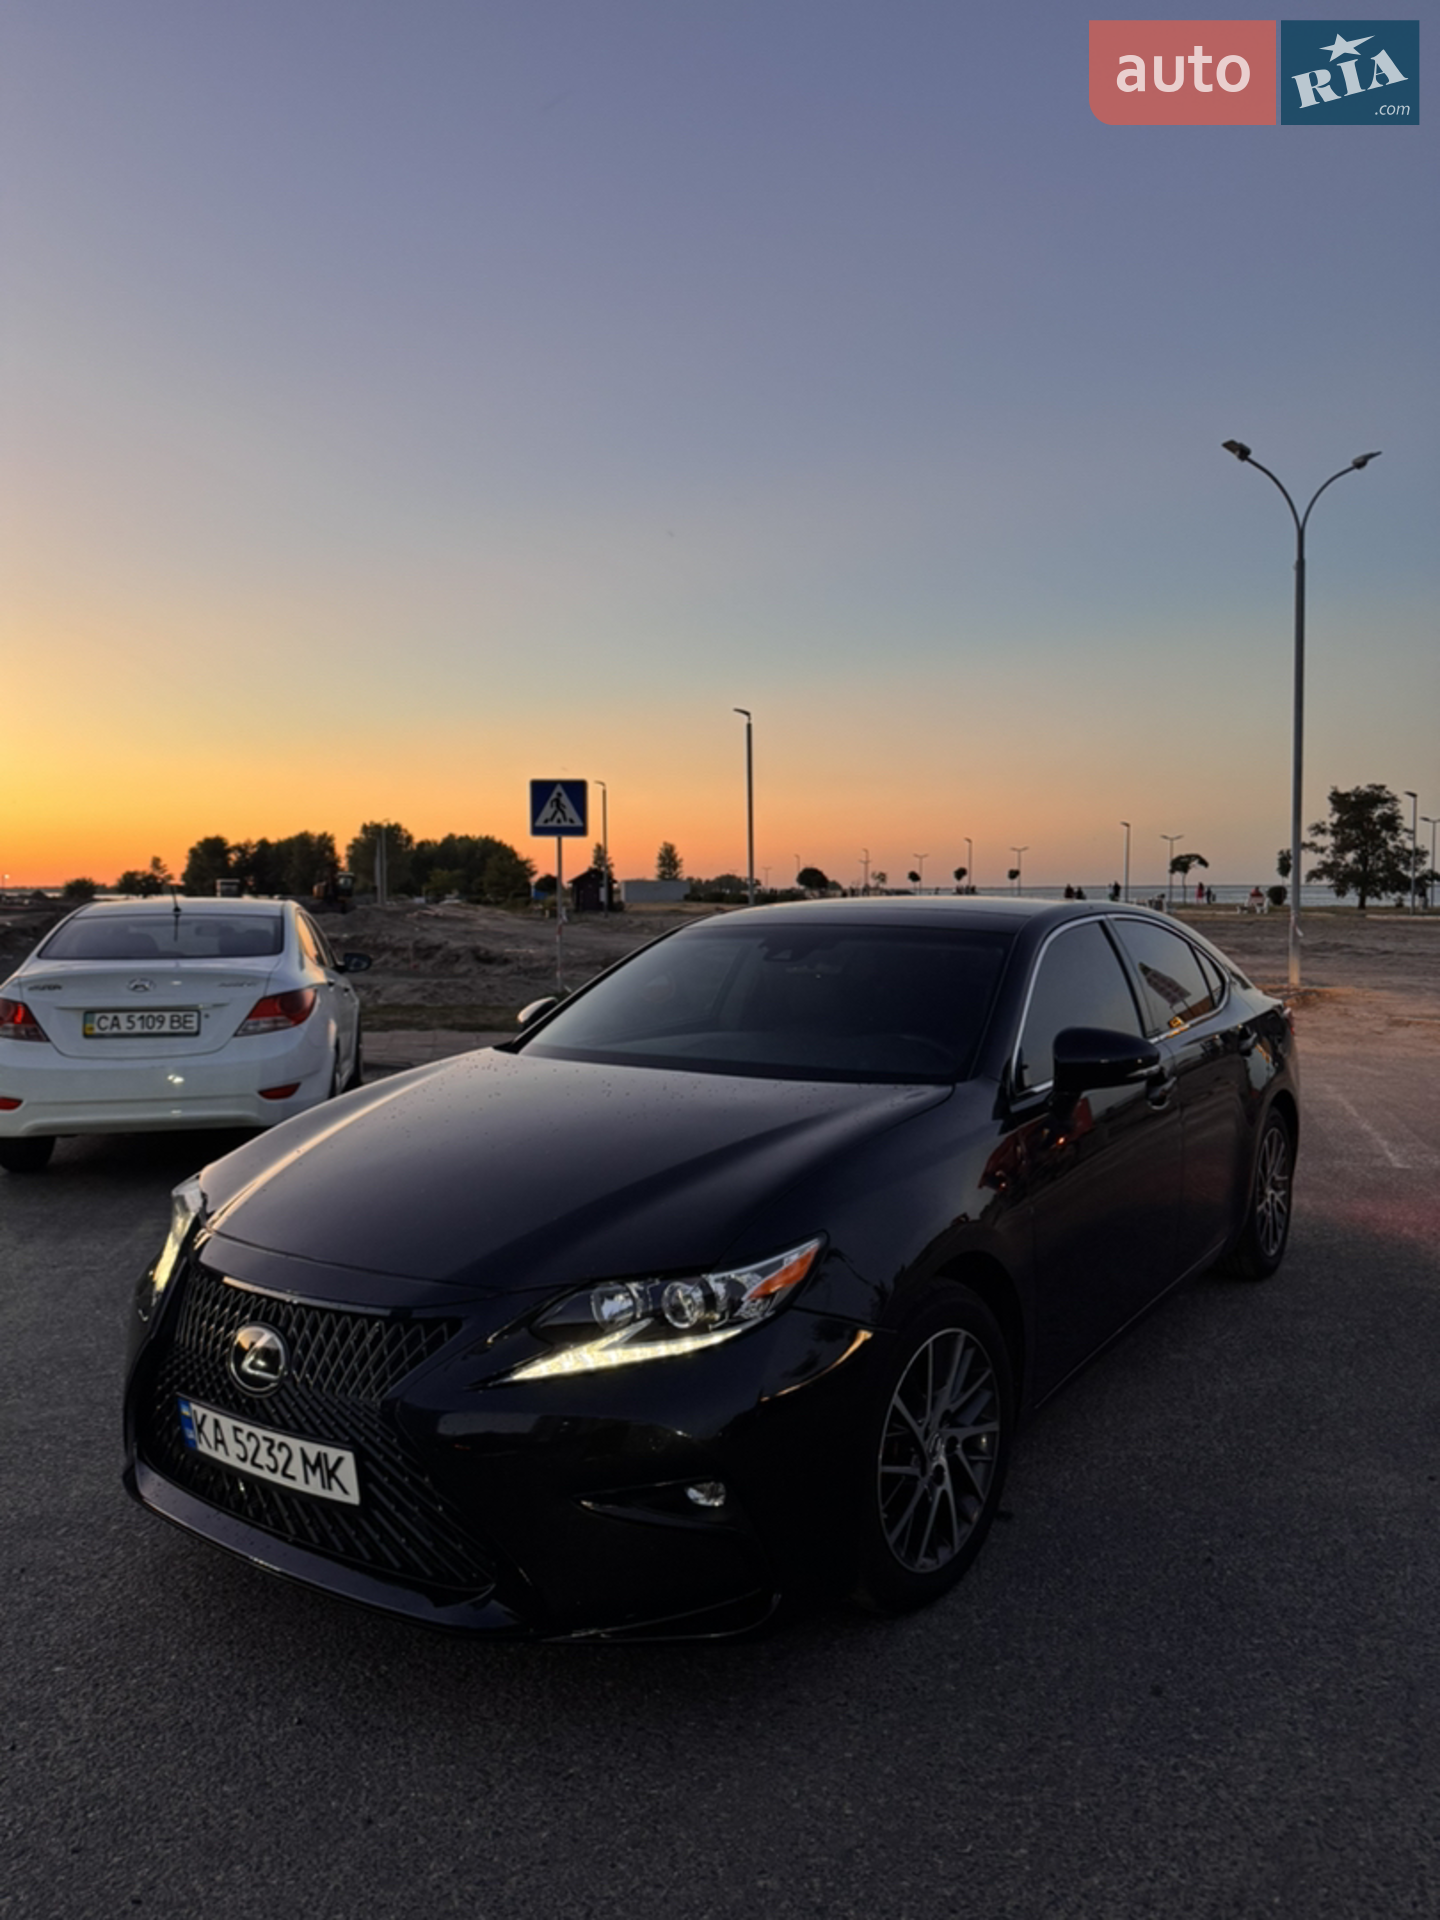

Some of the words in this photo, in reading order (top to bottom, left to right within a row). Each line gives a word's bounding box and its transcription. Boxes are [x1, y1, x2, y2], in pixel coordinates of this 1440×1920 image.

[97, 1014, 121, 1031] CA
[126, 1014, 166, 1031] 5109
[169, 1014, 195, 1030] BE
[193, 1409, 230, 1457] KA
[232, 1425, 297, 1482] 5232
[300, 1447, 350, 1496] MK
